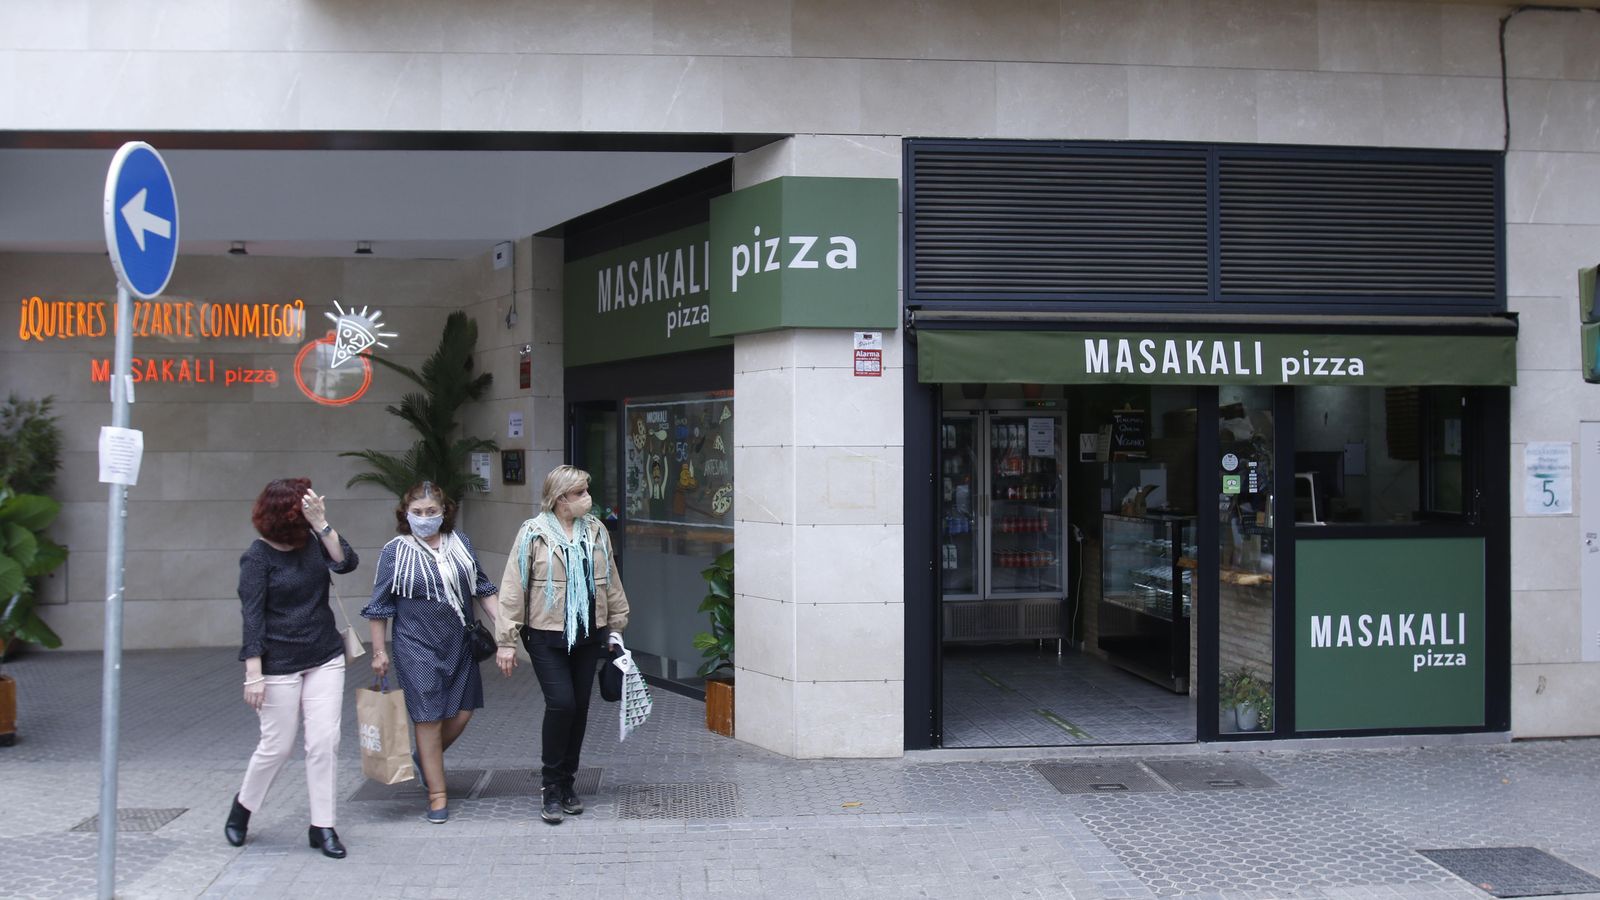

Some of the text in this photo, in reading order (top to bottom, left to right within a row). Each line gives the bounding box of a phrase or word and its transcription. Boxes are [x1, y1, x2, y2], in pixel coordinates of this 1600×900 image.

[598, 240, 709, 314] MASAKALI
[732, 226, 857, 292] pizza
[114, 300, 194, 338] ZZARTE
[200, 299, 304, 338] CONMIGO?
[667, 302, 709, 338] pizza
[91, 358, 278, 387] MSAKALI pizza
[1084, 338, 1364, 383] MASAKALI pizza
[1311, 613, 1466, 672] MASAKALI pizza
